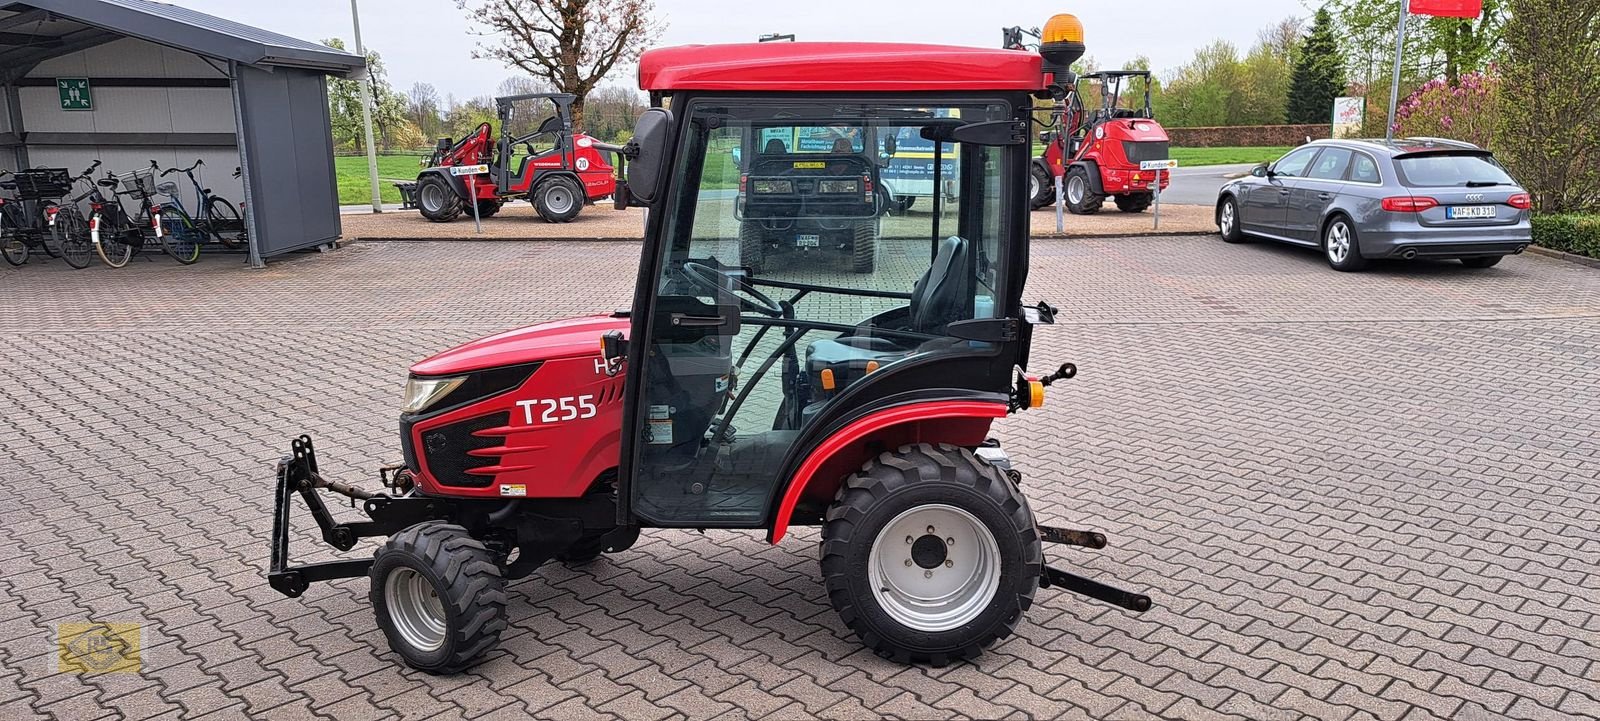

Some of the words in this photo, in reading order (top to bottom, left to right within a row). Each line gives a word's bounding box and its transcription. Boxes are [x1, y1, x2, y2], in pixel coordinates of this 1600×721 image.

[579, 160, 587, 169] 20
[1452, 207, 1466, 215] WAF
[1482, 207, 1495, 215] 318
[516, 394, 597, 424] T255
